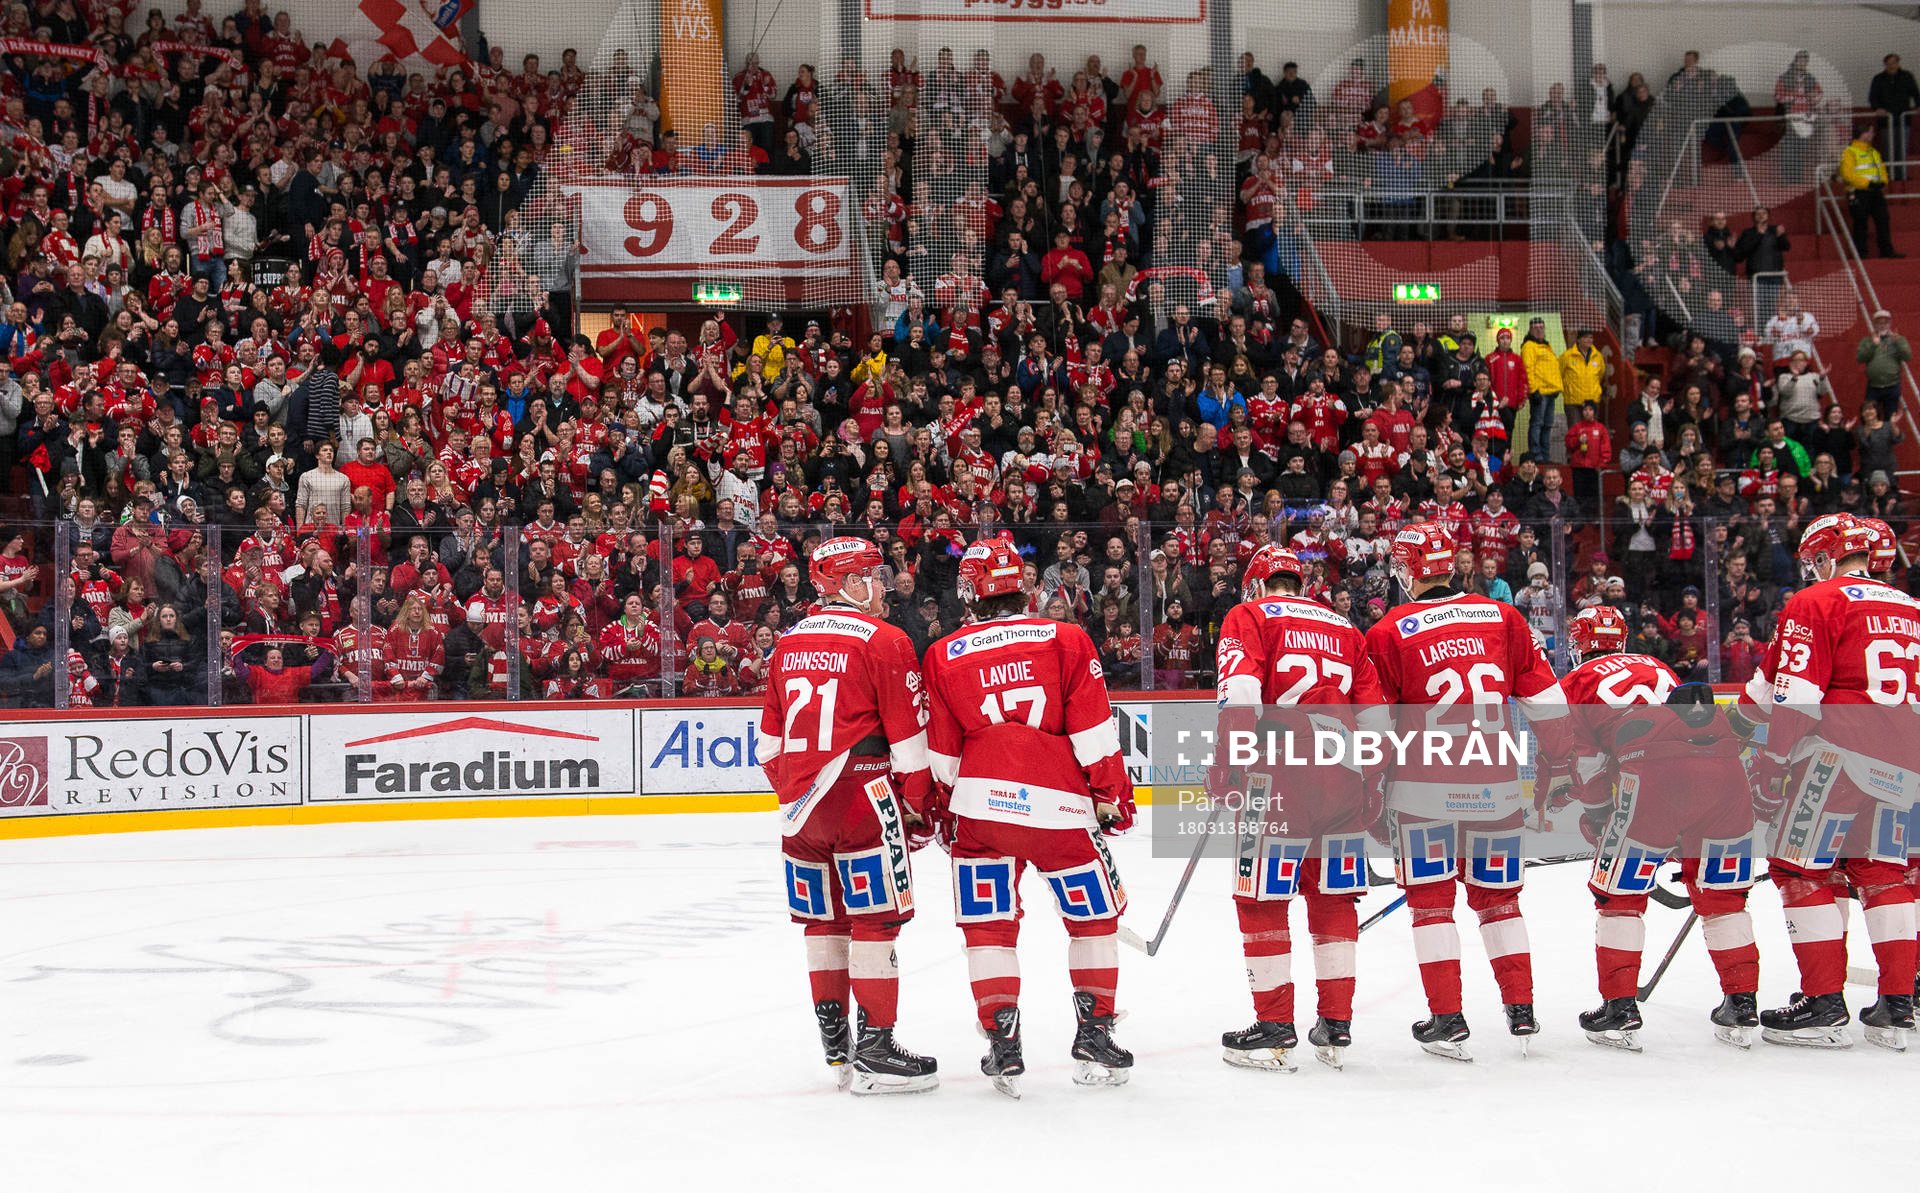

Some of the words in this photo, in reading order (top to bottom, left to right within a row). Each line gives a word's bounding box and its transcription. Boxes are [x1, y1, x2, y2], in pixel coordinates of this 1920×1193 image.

[672, 15, 711, 40] VVS
[50, 43, 94, 59] VIRKET
[799, 619, 826, 632] Grant
[826, 618, 872, 637] Thornton
[971, 633, 1004, 647] Grant
[1866, 615, 1920, 640] LILJENDA
[1284, 629, 1344, 657] KINNVALL
[1419, 637, 1486, 667] LARSSON
[782, 651, 848, 673] JOHNSSON
[979, 660, 1034, 688] LAVOIE
[1276, 653, 1352, 709] 27
[980, 685, 1047, 730] 17
[1425, 663, 1505, 737] 26
[784, 676, 839, 754] 21
[64, 728, 289, 781] RedoVis
[345, 751, 600, 794] Faradium
[66, 781, 288, 805] REVISION
[786, 782, 817, 821] teamsters
[1445, 800, 1496, 809] teamsters
[1788, 760, 1835, 848] PEAB
[876, 794, 910, 893] PEAB
